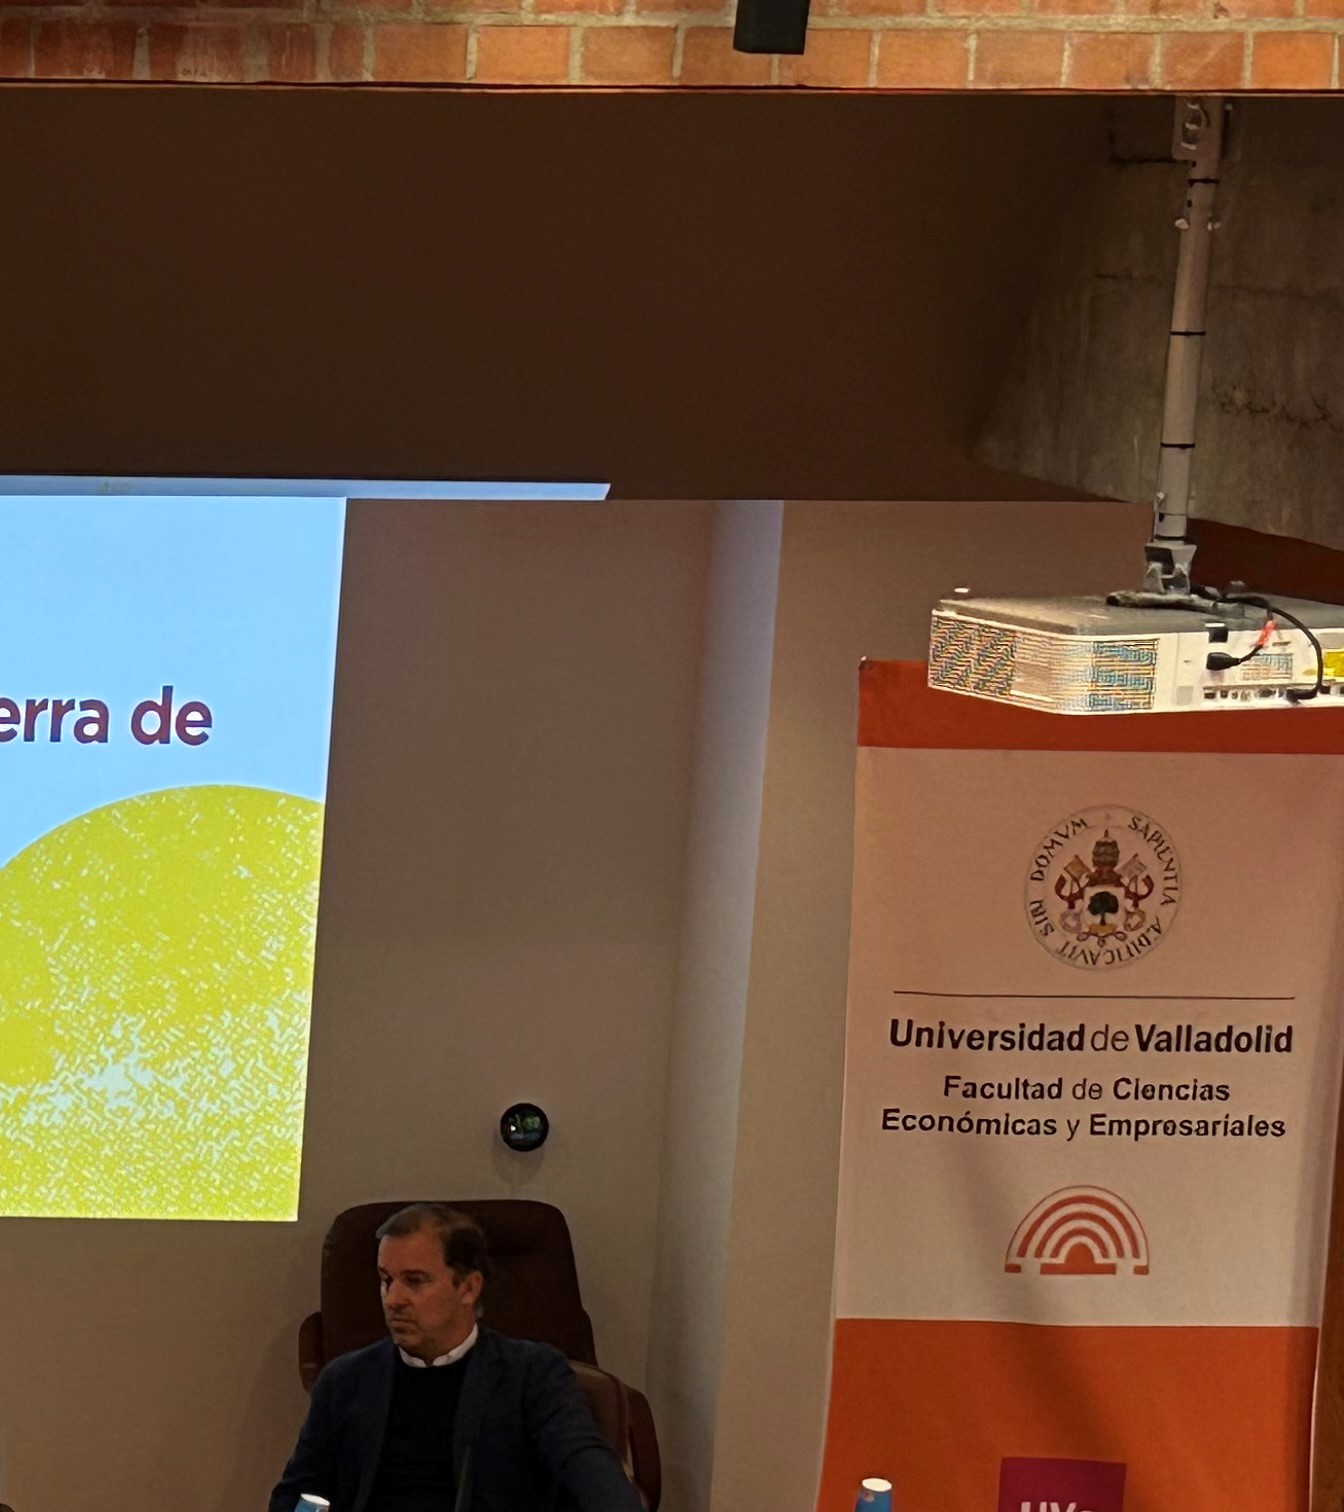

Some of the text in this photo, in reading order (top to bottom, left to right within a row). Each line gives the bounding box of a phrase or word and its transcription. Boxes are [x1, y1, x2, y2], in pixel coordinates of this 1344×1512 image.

[131, 686, 213, 747] de
[890, 1018, 1293, 1053] Universidad de Valladolid
[943, 1075, 1231, 1102] Facultad de Ciencias
[881, 1108, 1286, 1142] Económicas y Empresariales
